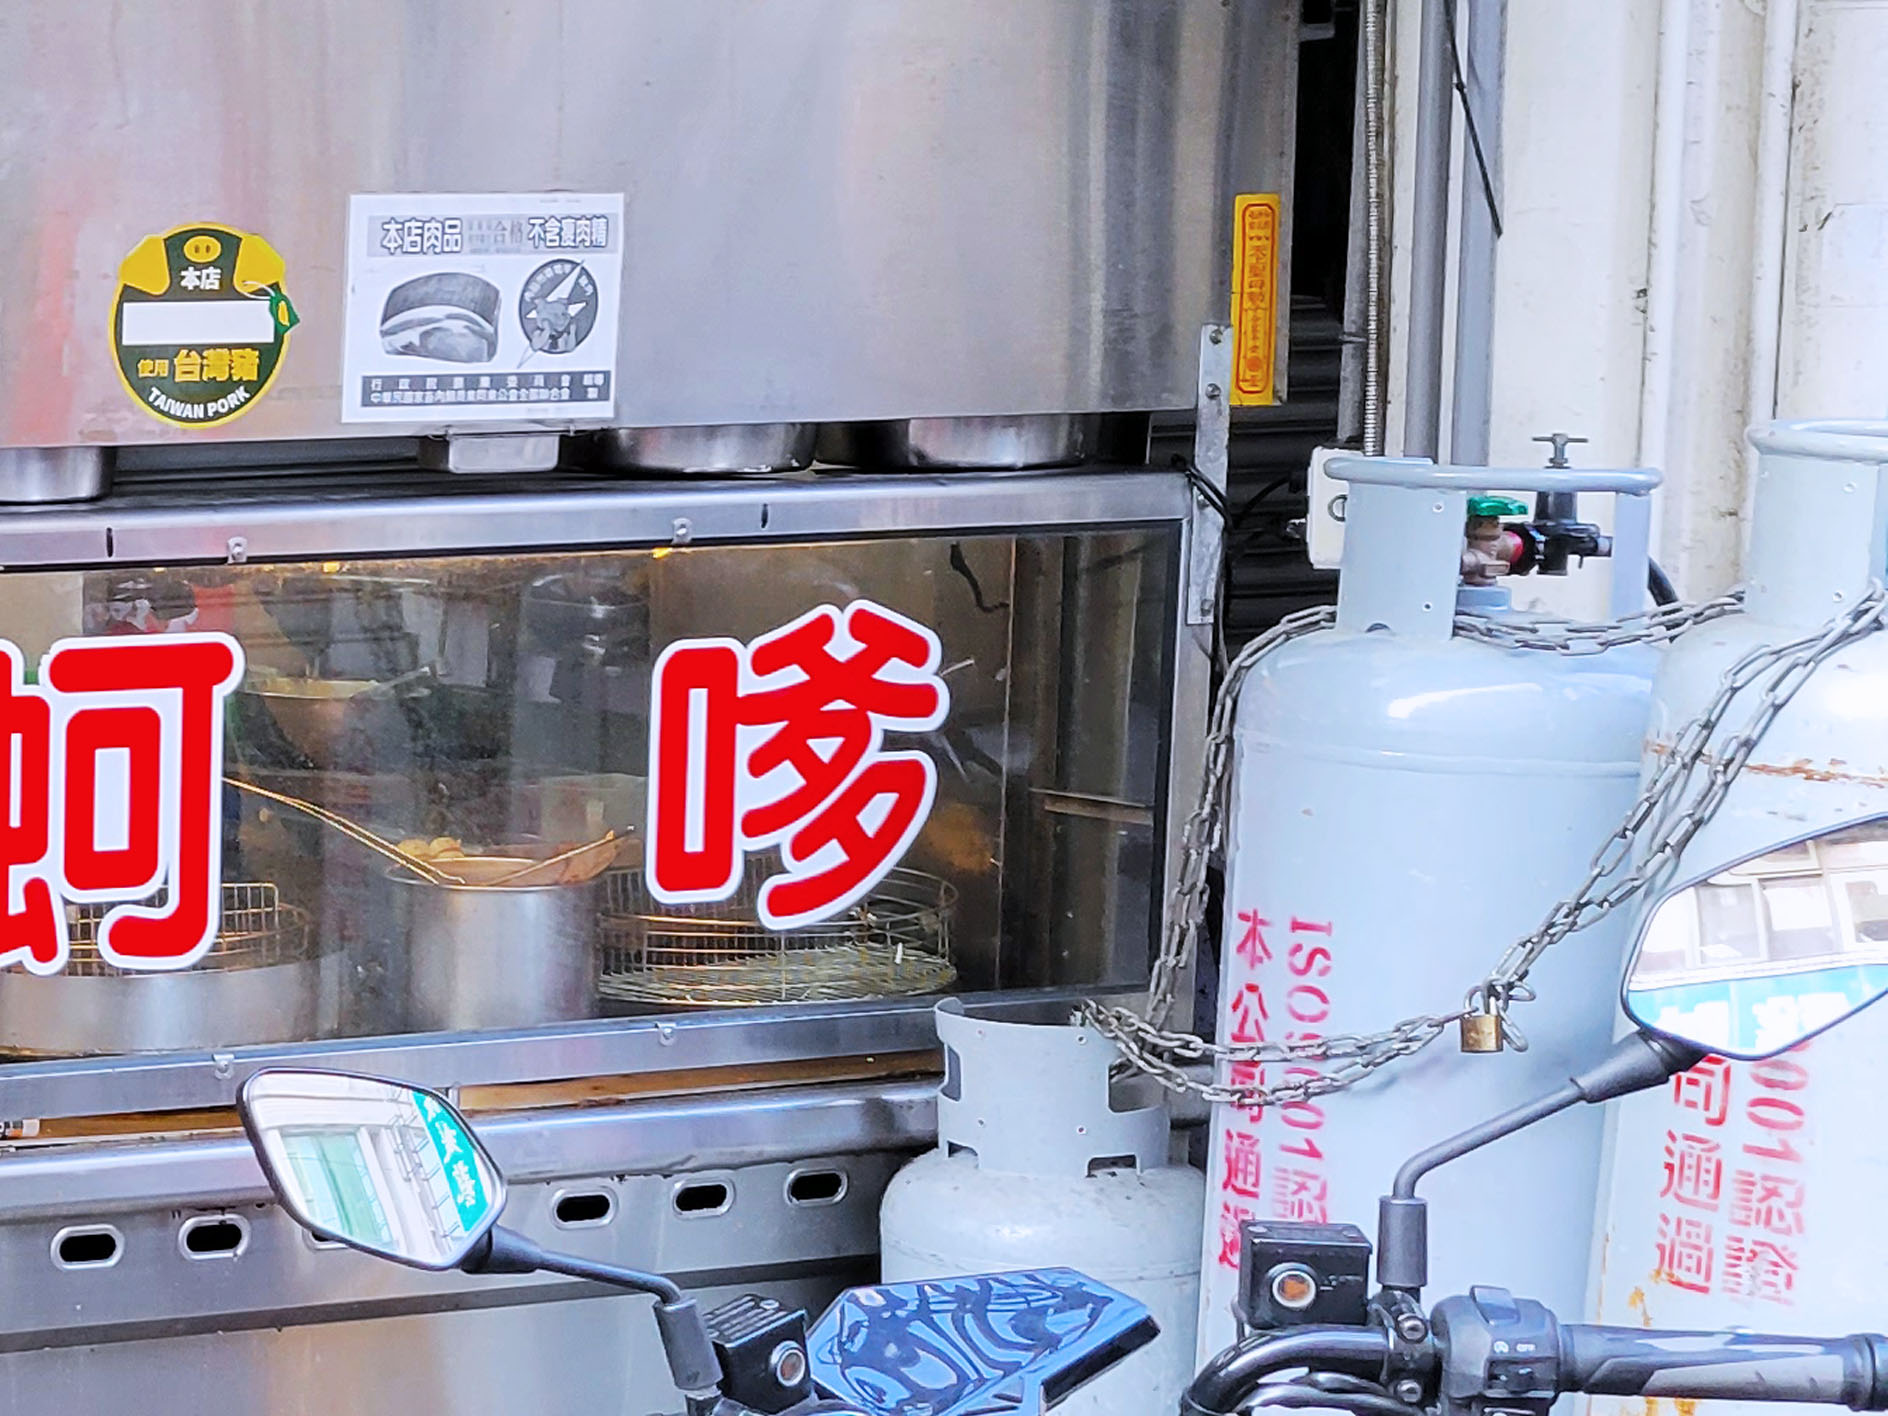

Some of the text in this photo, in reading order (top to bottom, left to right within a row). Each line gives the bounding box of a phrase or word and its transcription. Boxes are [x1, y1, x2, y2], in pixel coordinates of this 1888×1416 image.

[381, 216, 463, 255] 本店肉品
[527, 215, 609, 248] 不含瘦肉精
[180, 266, 222, 290] 本店
[148, 385, 251, 419] TAIWAN PORK
